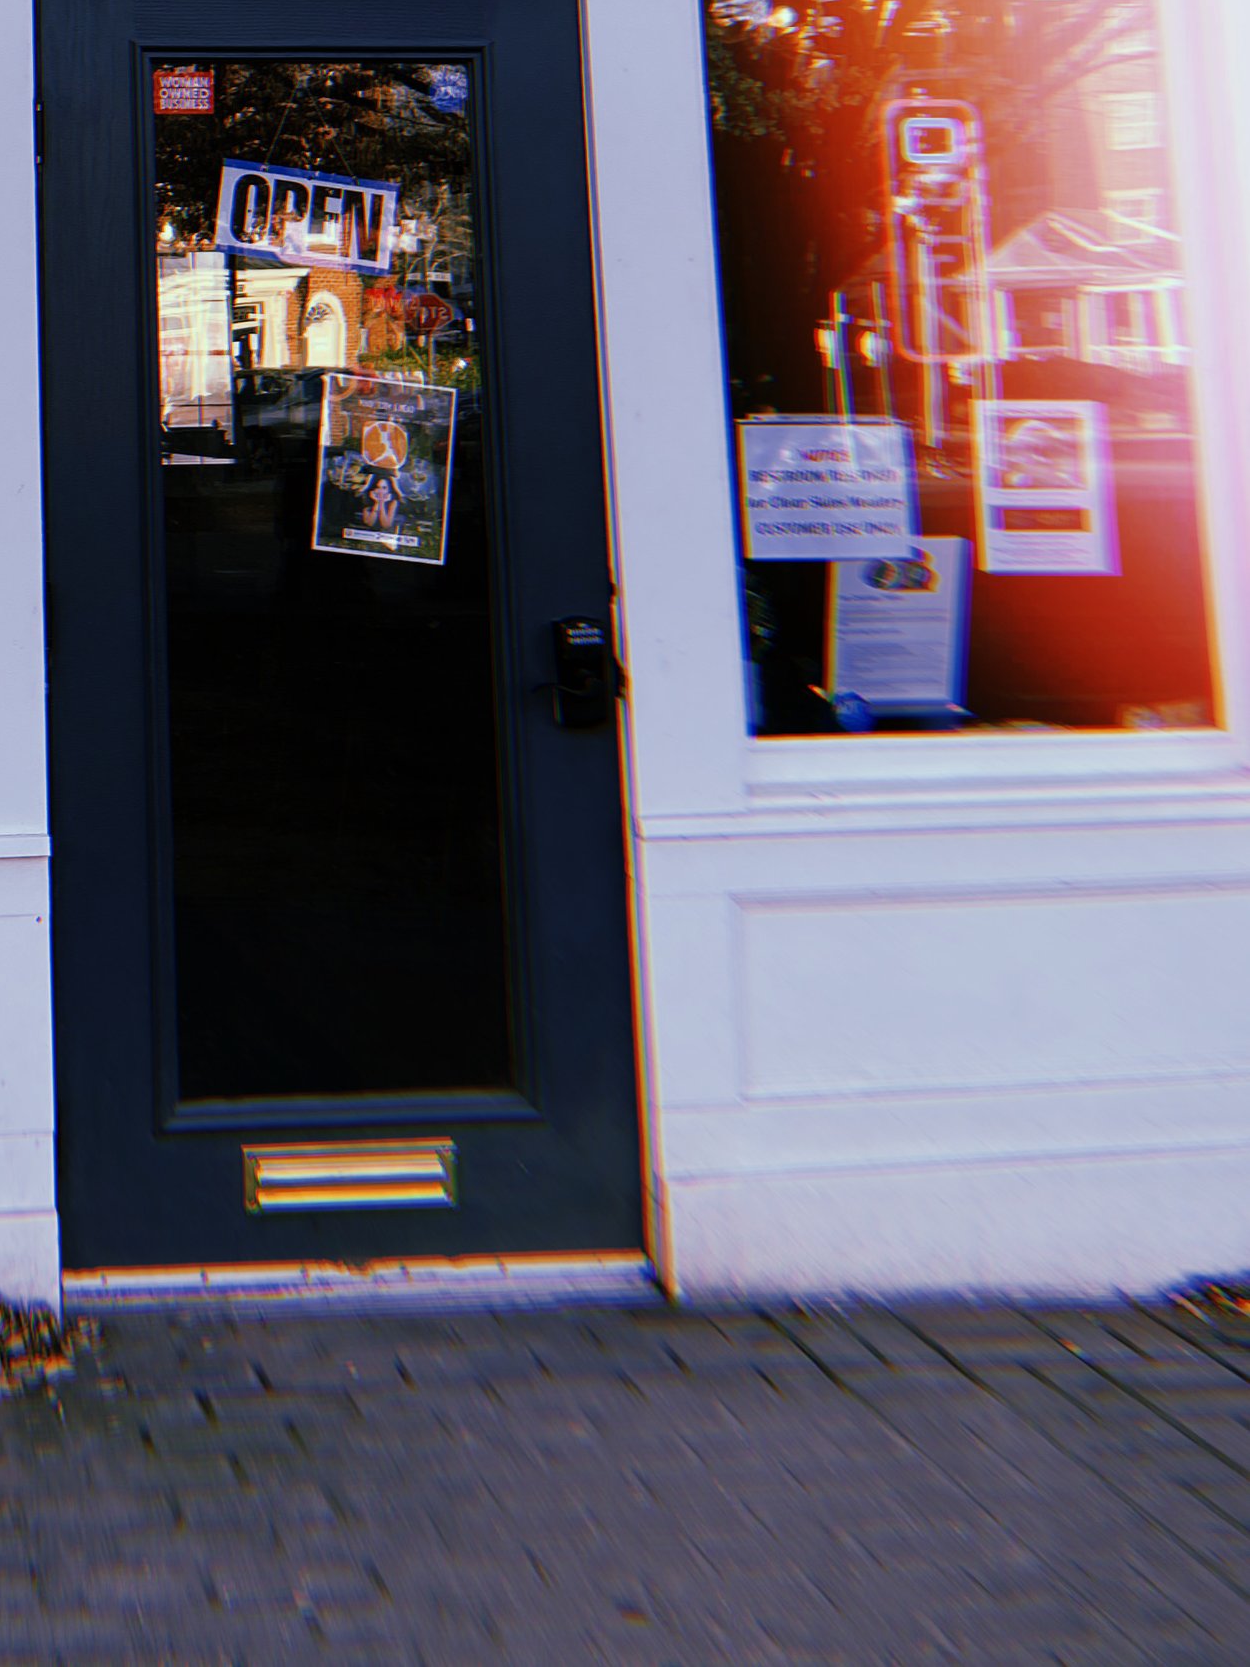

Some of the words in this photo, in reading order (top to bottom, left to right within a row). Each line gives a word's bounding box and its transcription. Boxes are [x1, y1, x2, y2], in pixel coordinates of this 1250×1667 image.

[159, 76, 209, 87] WOMAN
[159, 88, 210, 99] OWNED
[159, 99, 210, 110] BUSINESS
[230, 173, 384, 262] OPEN
